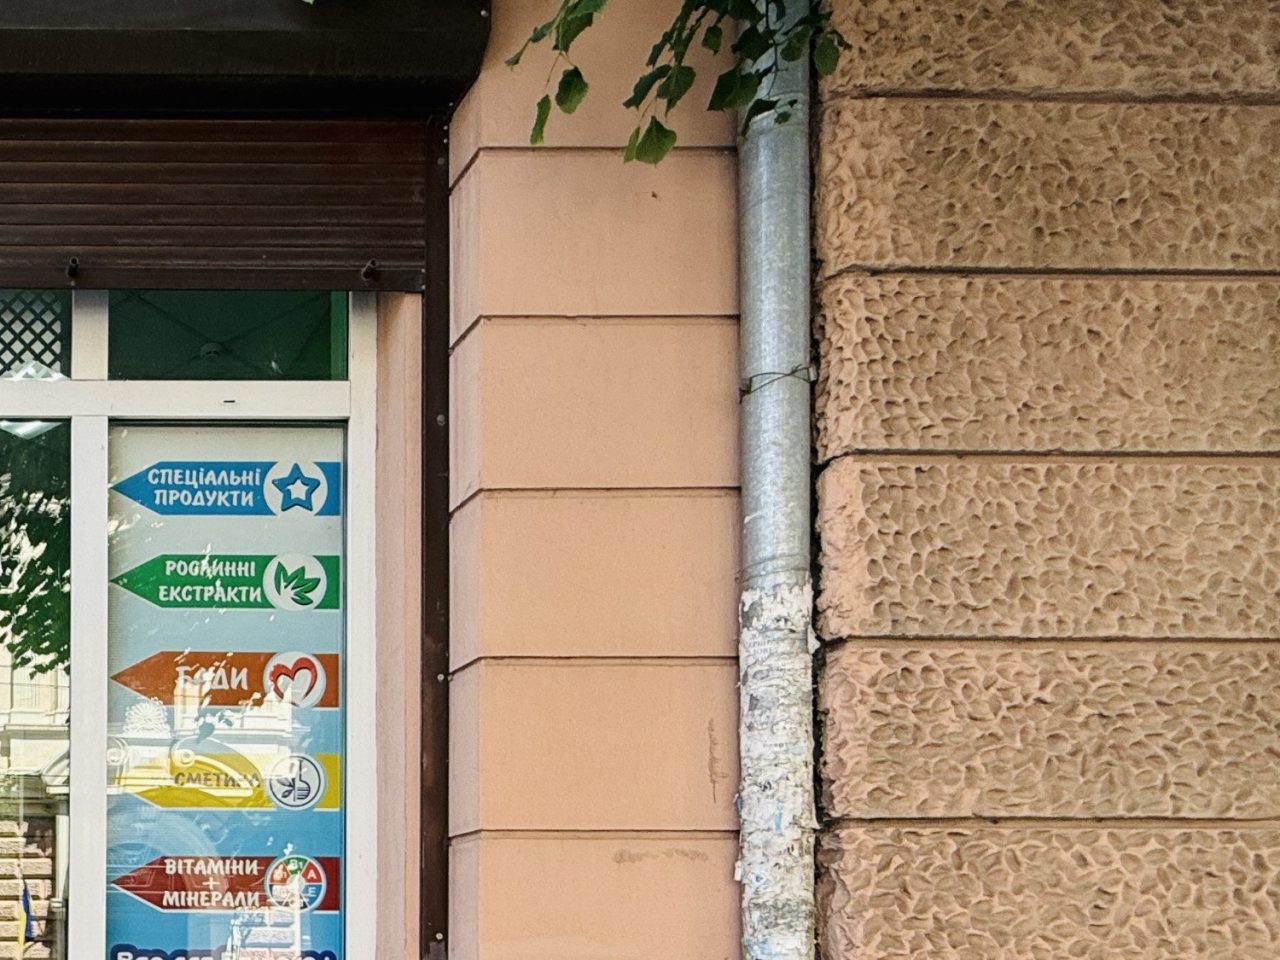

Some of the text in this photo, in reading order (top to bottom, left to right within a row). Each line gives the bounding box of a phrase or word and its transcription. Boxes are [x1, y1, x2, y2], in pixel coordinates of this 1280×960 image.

[154, 489, 254, 507] ПРОДУКТИ
[158, 585, 262, 603] ЕКСТРАКТИ
[164, 858, 259, 875] ВІТАМІНИ
[162, 890, 260, 907] МІНЕРАЛИ
